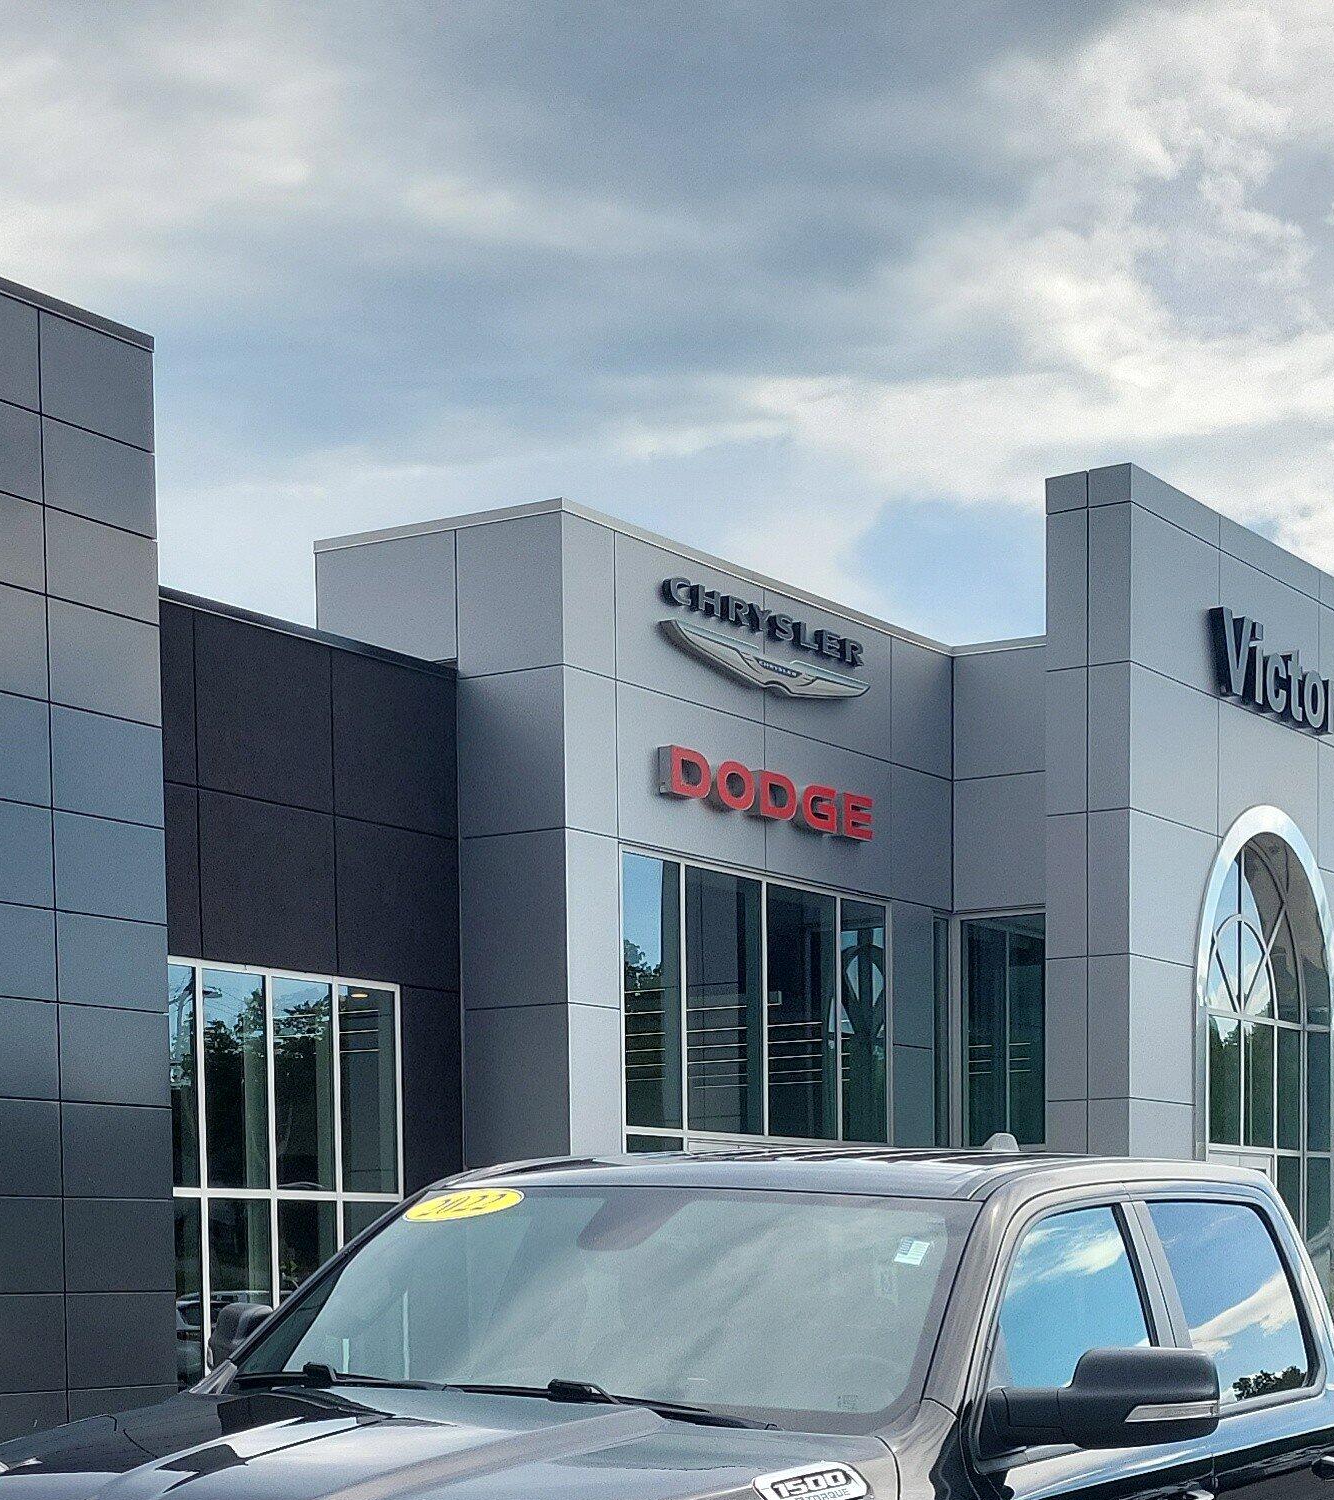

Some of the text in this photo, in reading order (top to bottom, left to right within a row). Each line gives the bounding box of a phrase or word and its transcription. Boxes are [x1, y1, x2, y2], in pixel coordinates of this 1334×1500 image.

[662, 576, 865, 668] CHRYSLER
[660, 744, 875, 842] DODGE
[417, 1193, 508, 1218] 2022
[772, 1470, 850, 1499] 1500
